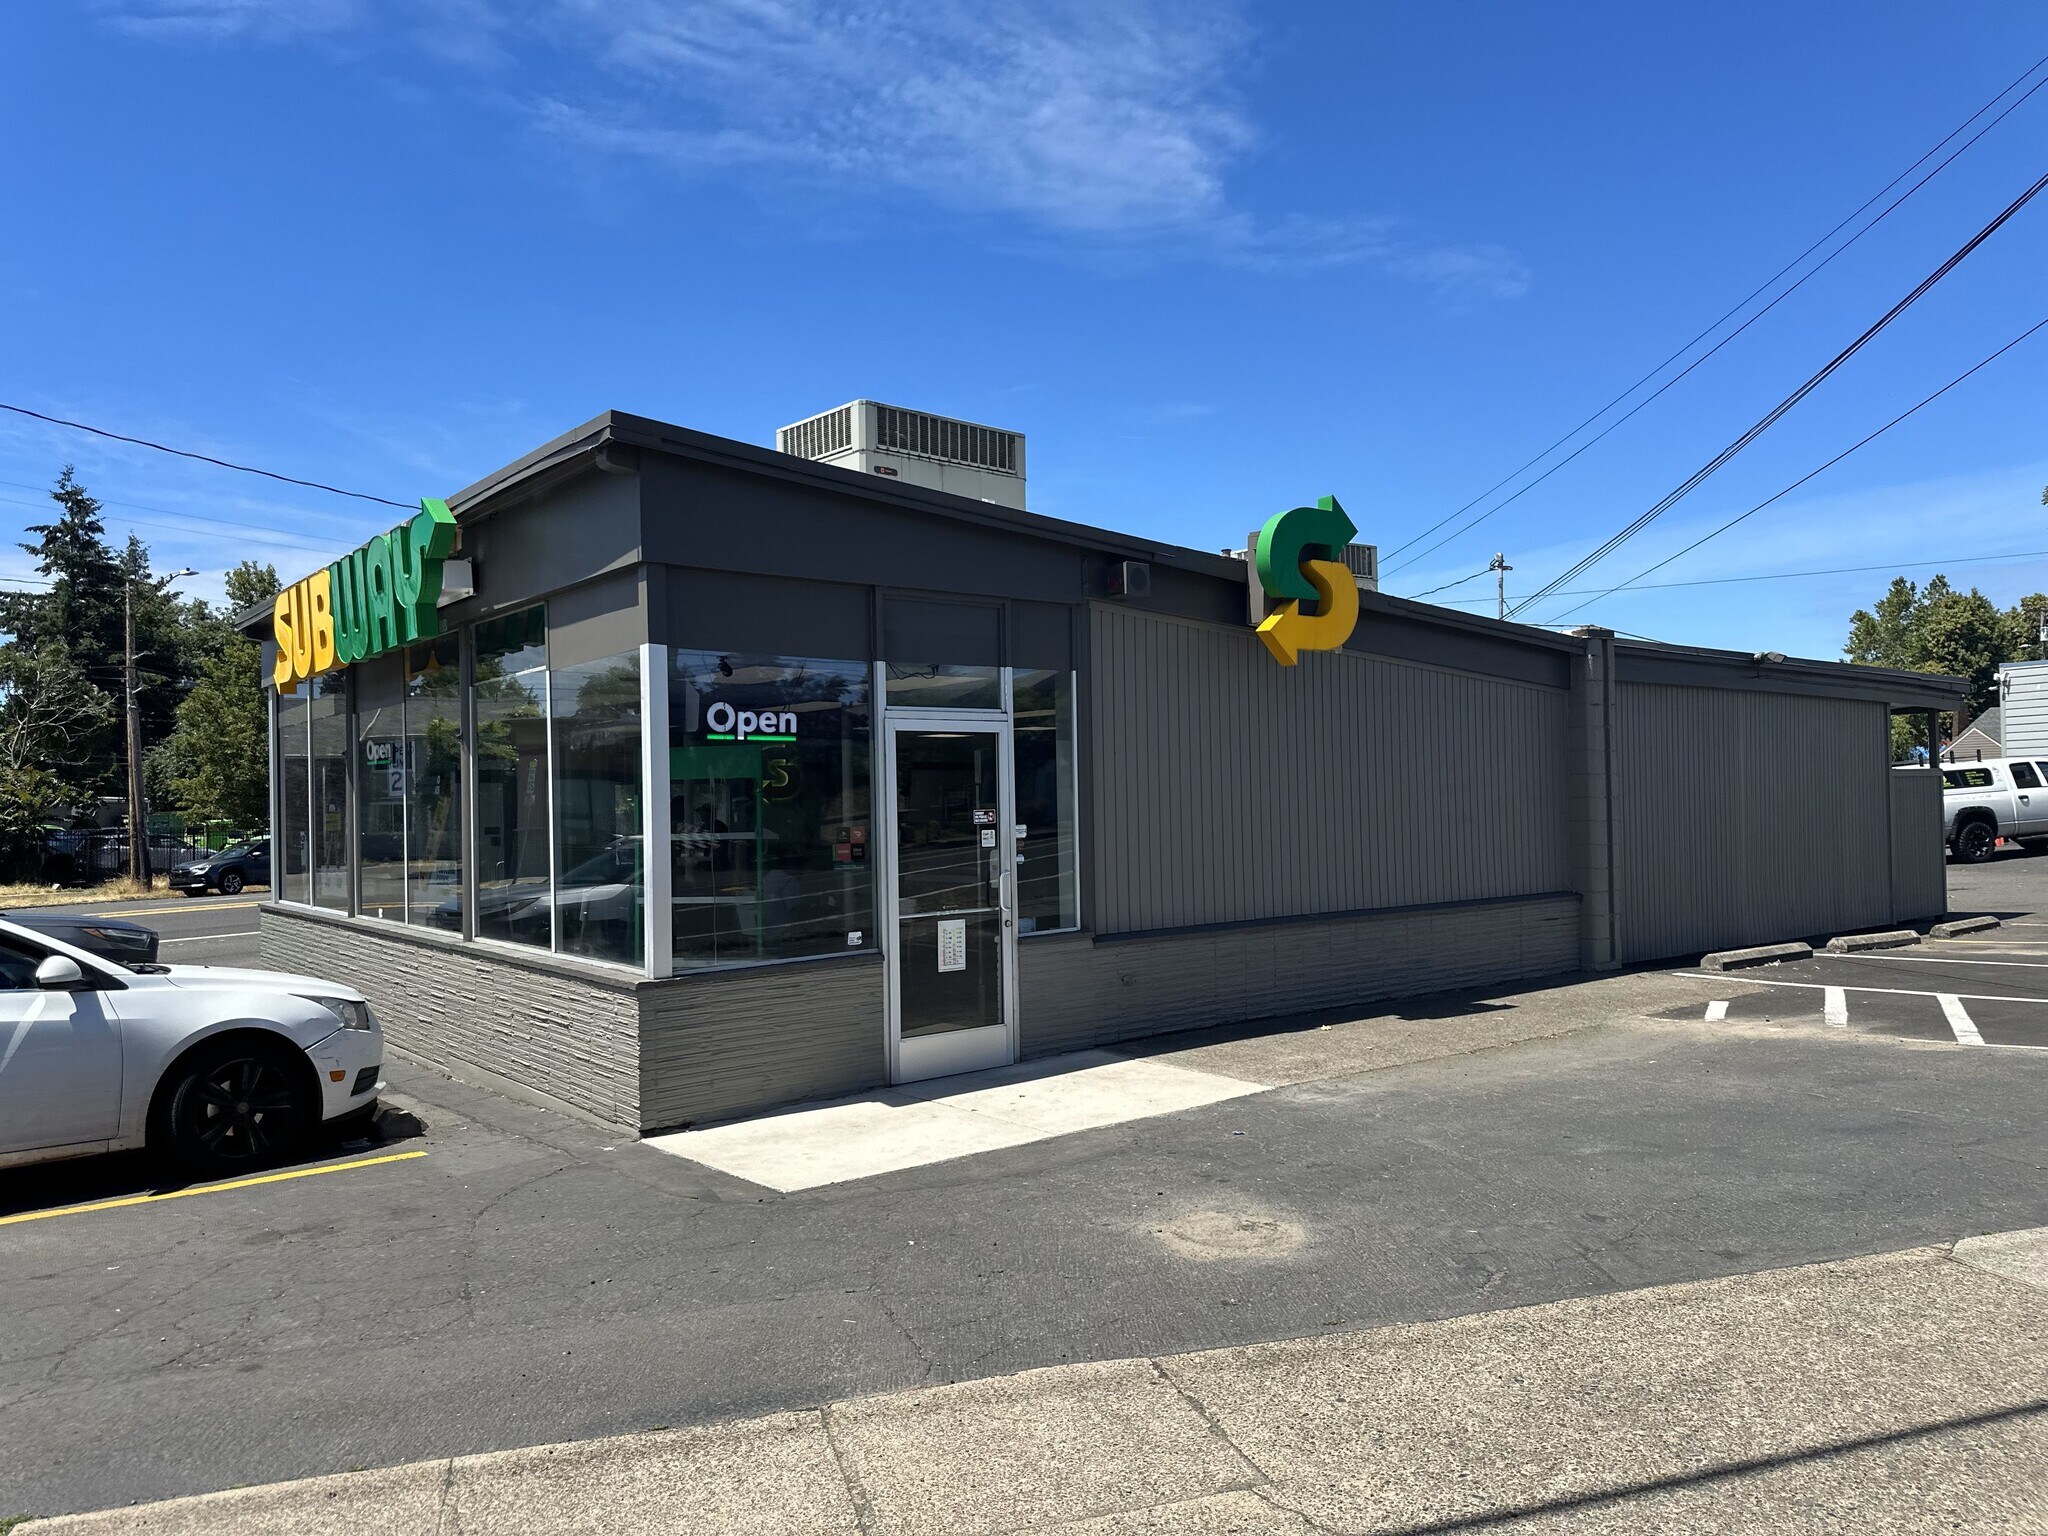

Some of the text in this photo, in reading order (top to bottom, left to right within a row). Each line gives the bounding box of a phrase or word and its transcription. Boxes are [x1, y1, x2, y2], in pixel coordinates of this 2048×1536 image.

[273, 498, 457, 695] SUBWAY
[706, 702, 797, 740] Open
[366, 740, 391, 764] Open
